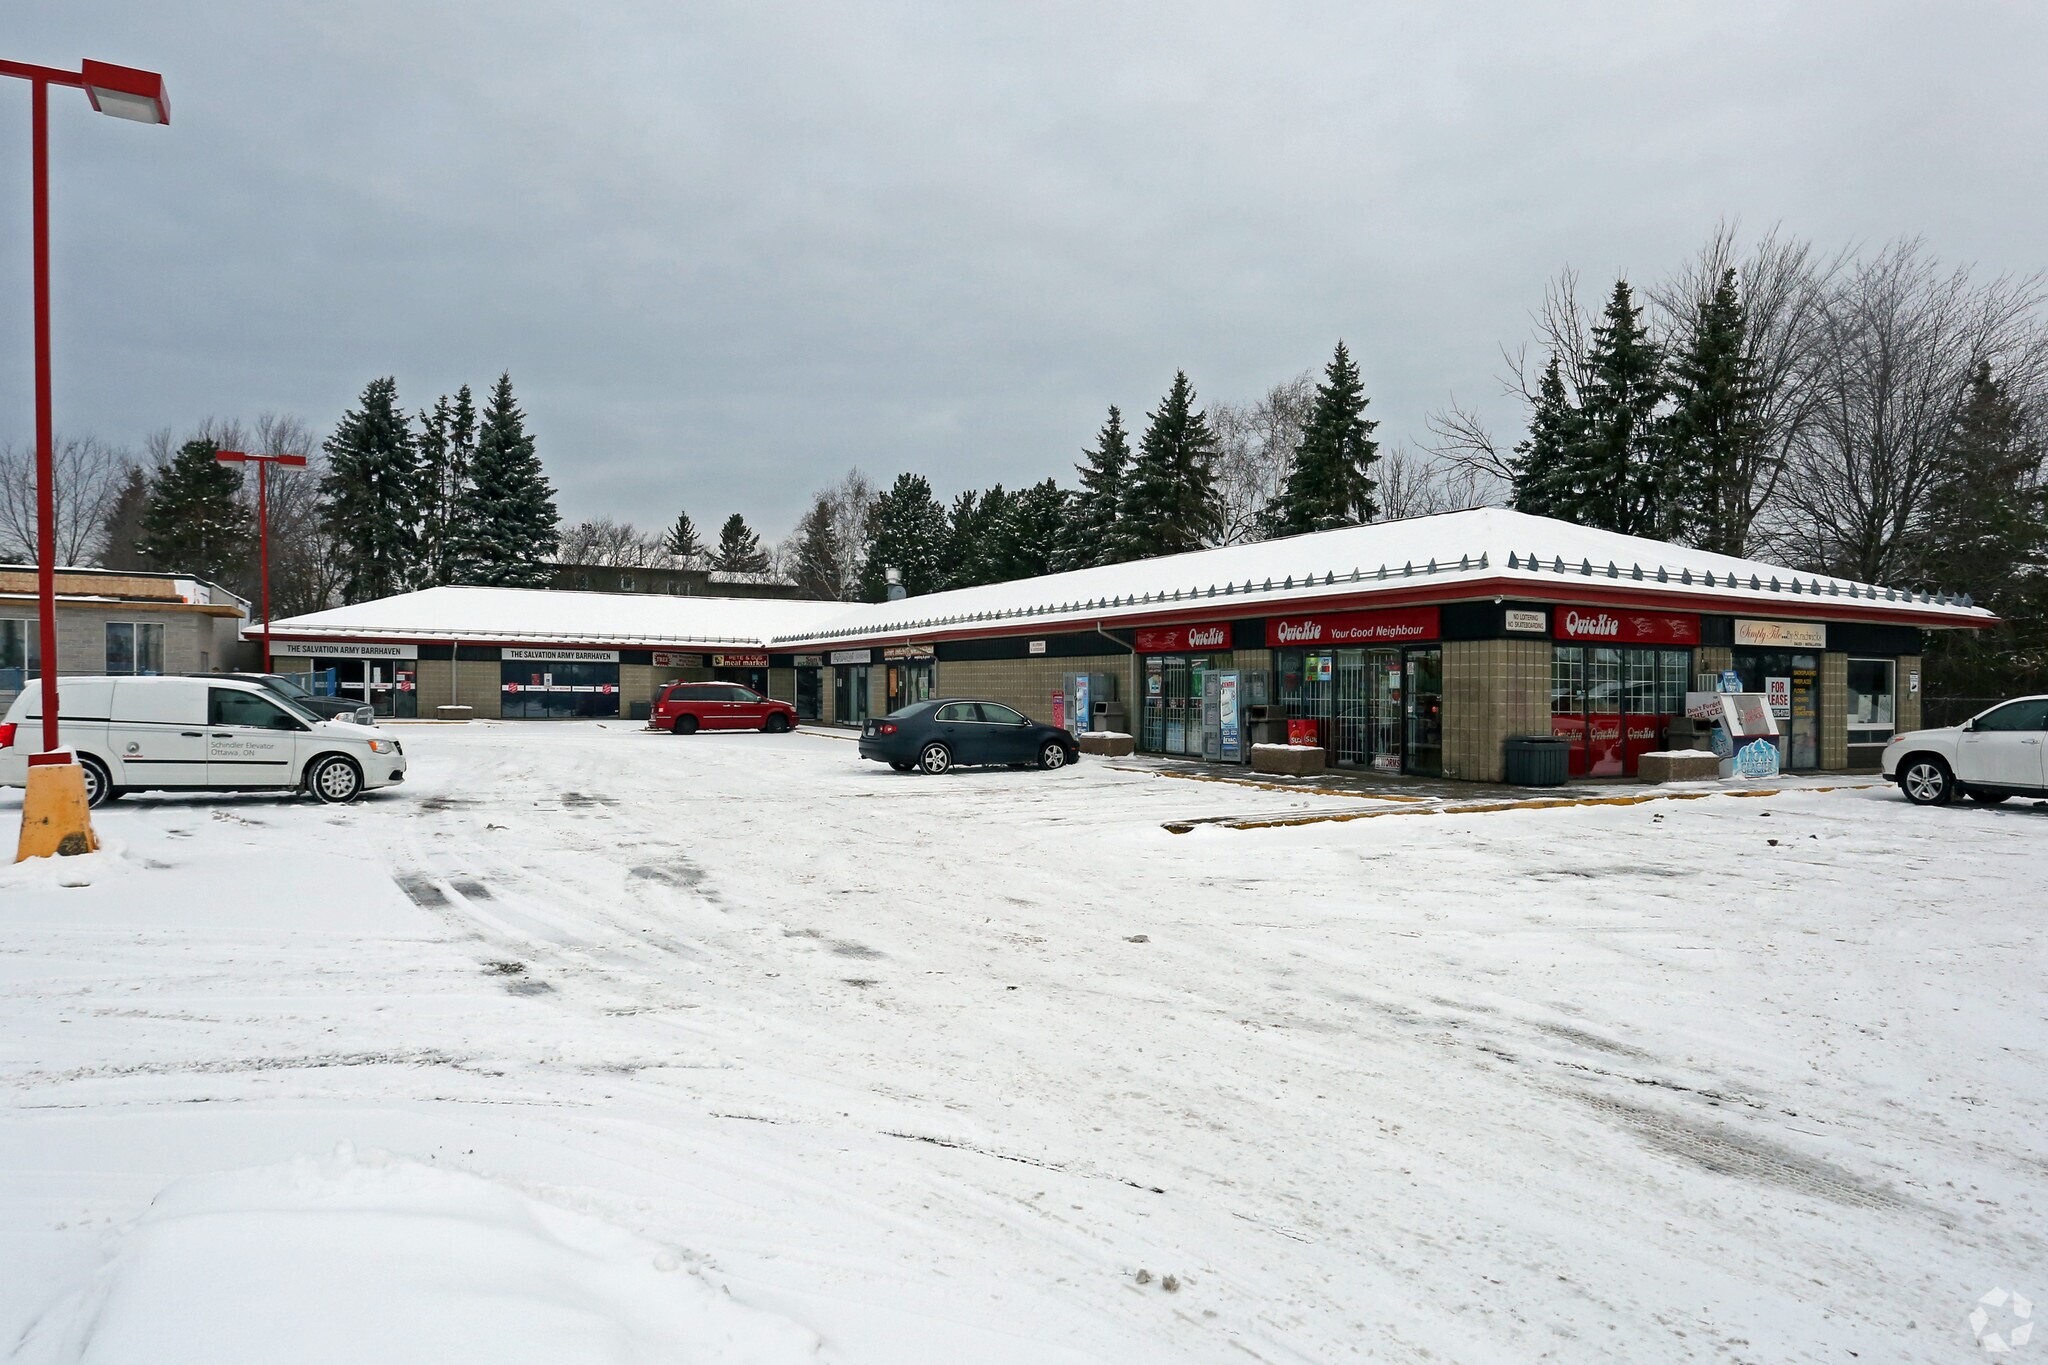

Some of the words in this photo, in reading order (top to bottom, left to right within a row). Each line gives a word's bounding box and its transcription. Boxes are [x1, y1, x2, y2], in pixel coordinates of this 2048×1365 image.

[1331, 629, 1350, 638] Your
[1351, 627, 1374, 638] Good
[1376, 625, 1424, 638] Neighbour
[1739, 624, 1767, 644] Simply
[1767, 625, 1781, 640] Tile
[287, 645, 301, 653] THE
[302, 645, 339, 654] SALVATION
[340, 646, 360, 654] ARMY
[361, 647, 401, 656] BARRHAVEN
[511, 650, 523, 658] THE
[524, 651, 555, 659] SALVATION
[557, 652, 575, 660] ARMY
[742, 659, 768, 667] market
[1771, 681, 1785, 693] FOR
[1768, 694, 1789, 706] LEASE
[1687, 705, 1702, 715] Don't
[1702, 700, 1722, 711] Forget
[1690, 711, 1706, 719] THE
[1707, 707, 1724, 717] ICE!
[211, 741, 244, 749] Schindler
[245, 742, 275, 750] Elevator
[211, 749, 241, 757] Ottawa,
